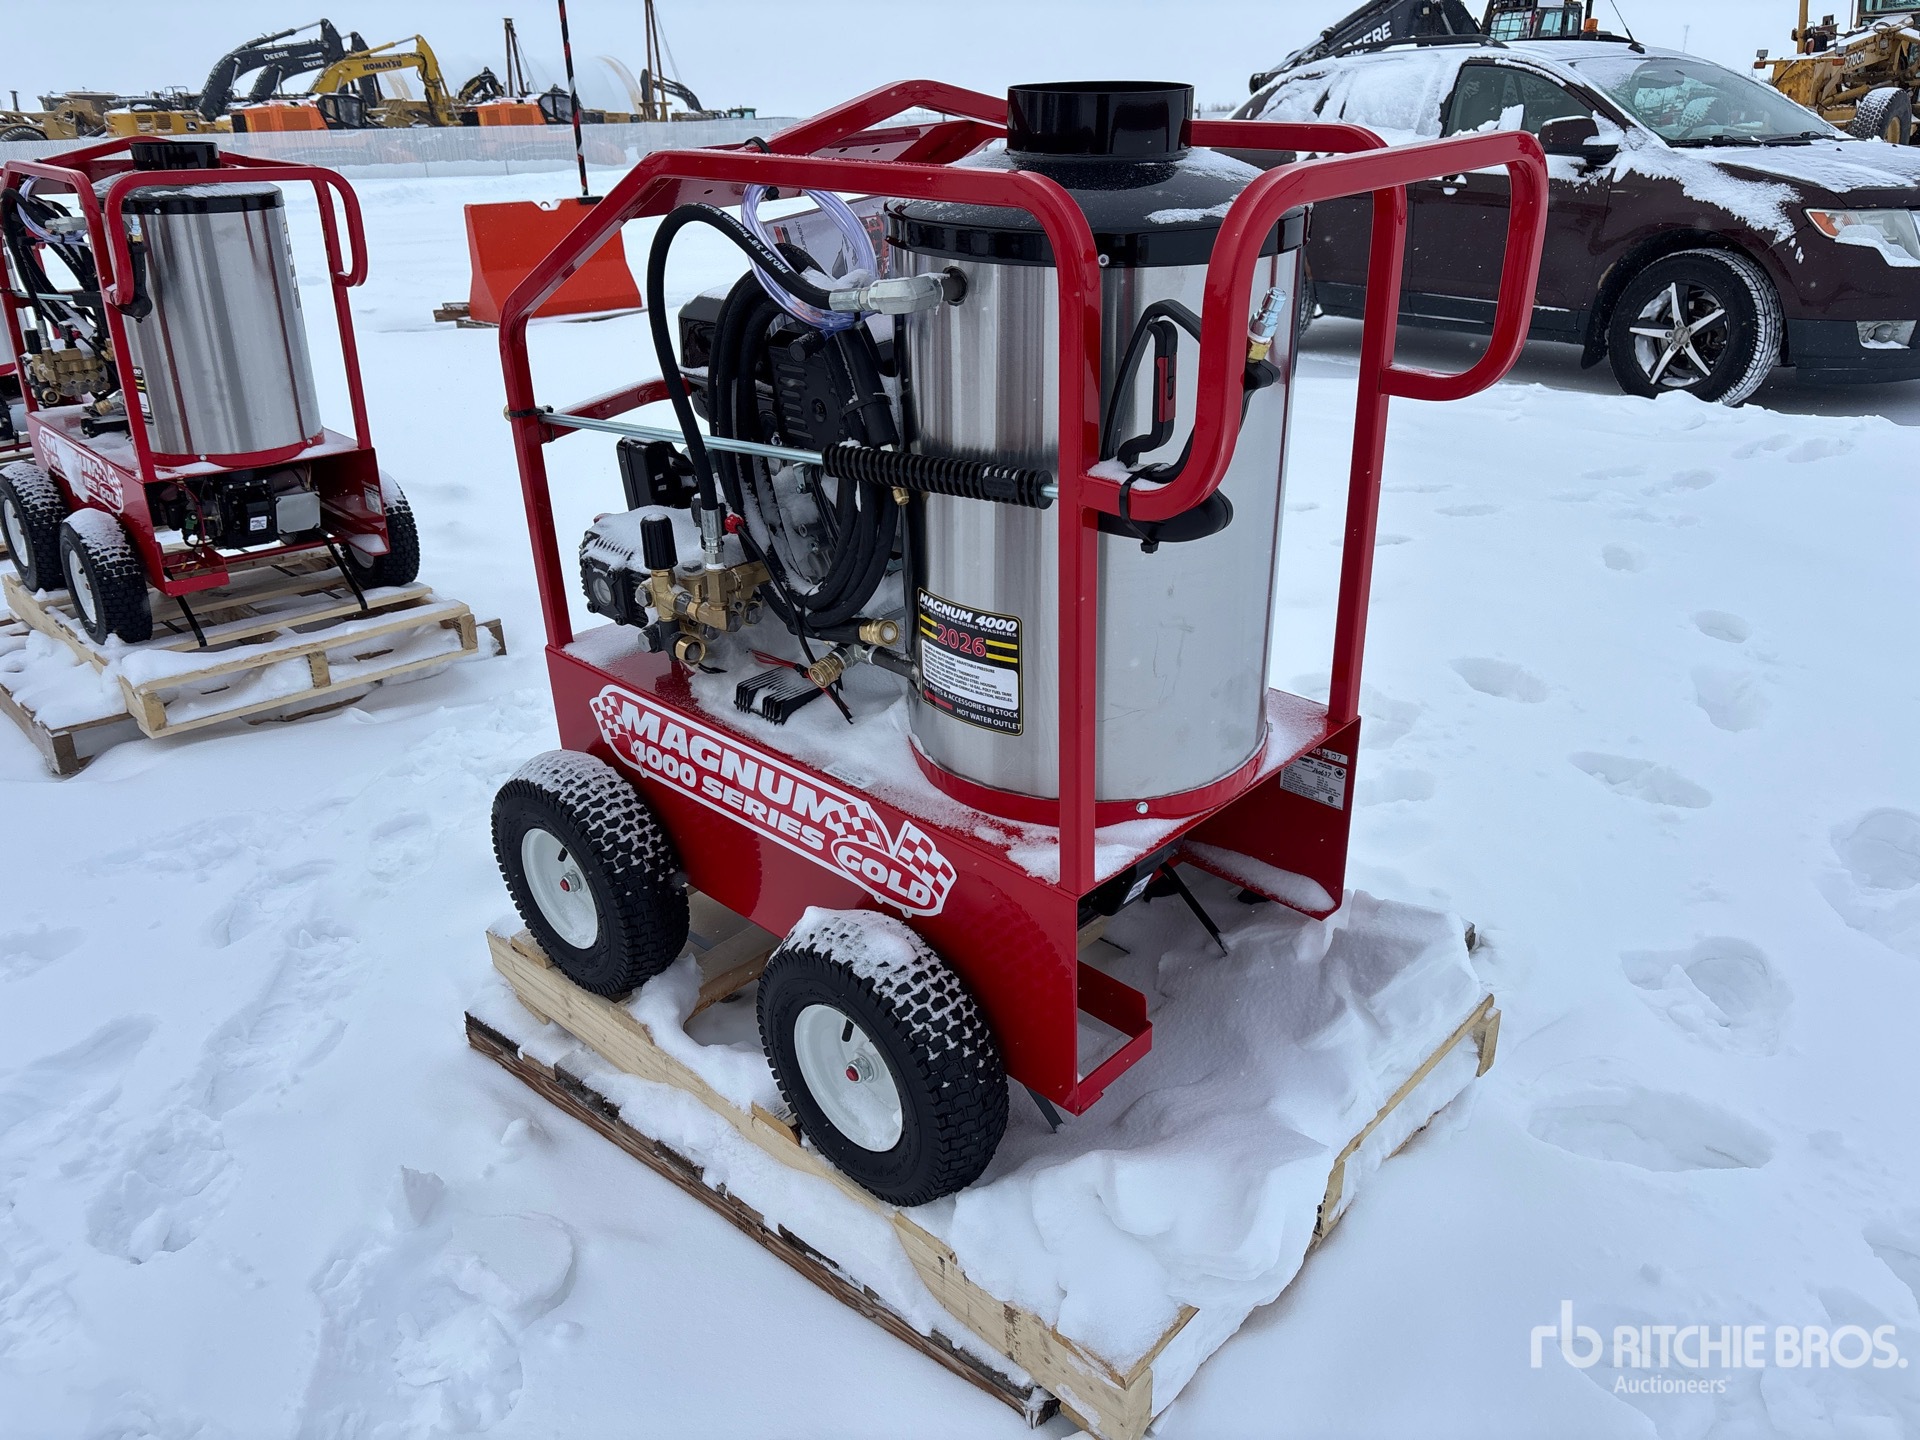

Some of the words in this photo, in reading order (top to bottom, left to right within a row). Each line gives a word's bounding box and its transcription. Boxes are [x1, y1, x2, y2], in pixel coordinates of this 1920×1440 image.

[263, 51, 289, 61] DEERE
[303, 58, 325, 69] DEERE
[363, 60, 402, 71] KOMATSU
[722, 214, 751, 238] Pressure
[761, 250, 790, 274] PROJET
[101, 488, 121, 508] GOLD
[920, 592, 973, 623] MAGNUM
[975, 615, 1018, 632] 4000
[929, 608, 946, 619] WATER
[946, 616, 979, 630] PRESSURE
[980, 627, 1017, 637] WASHERS
[937, 623, 987, 657] 2026
[930, 684, 944, 696] PARTS
[948, 693, 986, 712] ACCESSORIES
[986, 706, 994, 714] IN
[995, 708, 1019, 719] STOCK
[956, 707, 969, 717] HOT
[970, 710, 992, 724] WATER
[993, 718, 1021, 730] OUTLET
[620, 701, 849, 824] MAGNUM
[630, 740, 697, 788] 4000
[702, 776, 826, 851] SERIES
[837, 845, 931, 907] GOLD
